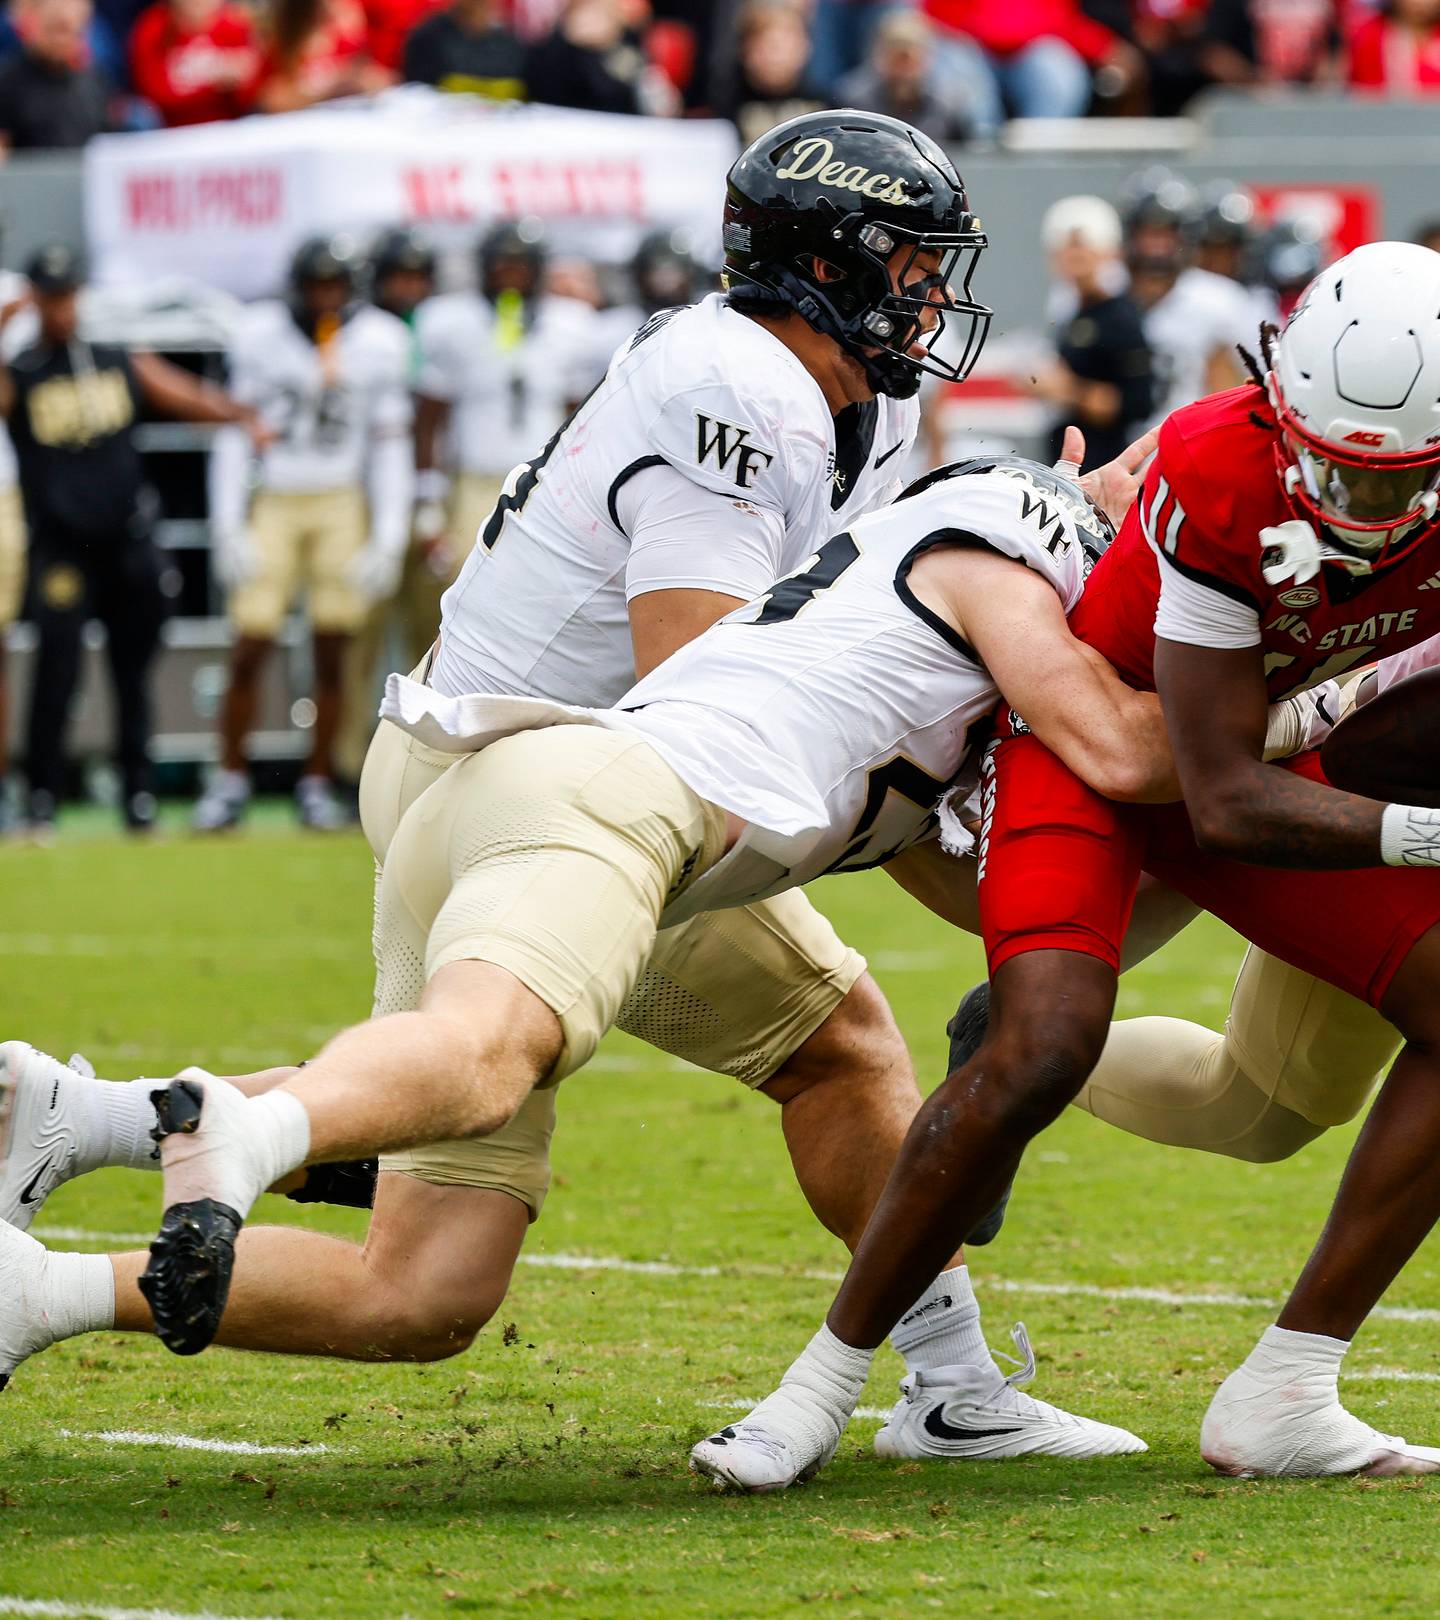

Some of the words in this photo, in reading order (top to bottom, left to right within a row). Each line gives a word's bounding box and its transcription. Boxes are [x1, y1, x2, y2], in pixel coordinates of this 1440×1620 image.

[776, 138, 910, 206] Deacs
[696, 412, 775, 489] WF
[1341, 430, 1387, 448] ACC
[1147, 474, 1187, 555] 11
[1265, 613, 1313, 644] NC
[1314, 607, 1420, 651] STATE
